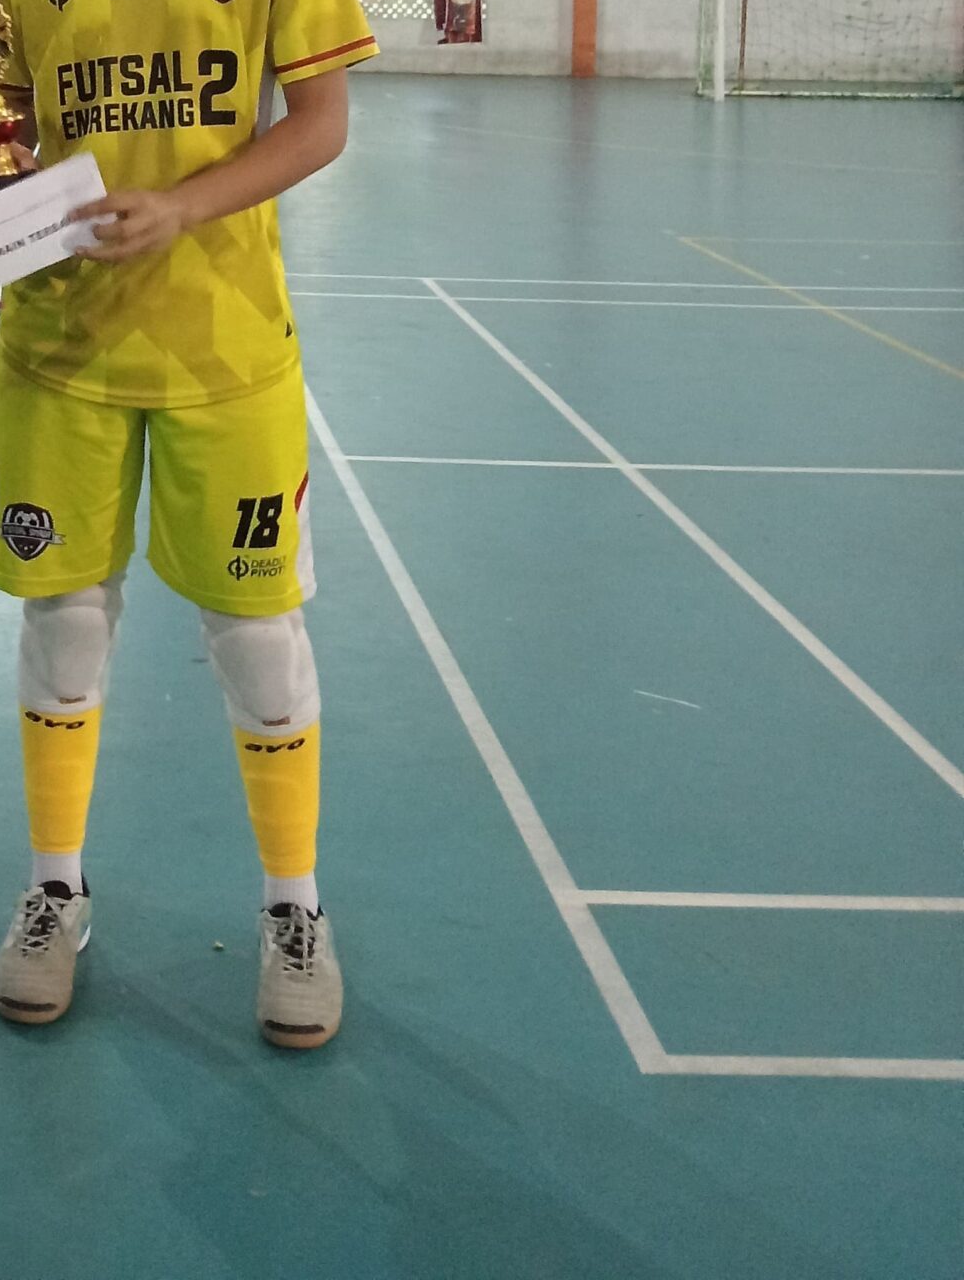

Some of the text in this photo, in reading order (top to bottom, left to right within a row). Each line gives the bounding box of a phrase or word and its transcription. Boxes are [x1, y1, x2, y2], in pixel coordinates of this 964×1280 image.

[57, 50, 193, 107] FUTSAL
[198, 49, 239, 126] 2
[61, 98, 194, 141] ENREKANG
[232, 492, 284, 549] 18
[250, 567, 284, 578] PIVOT
